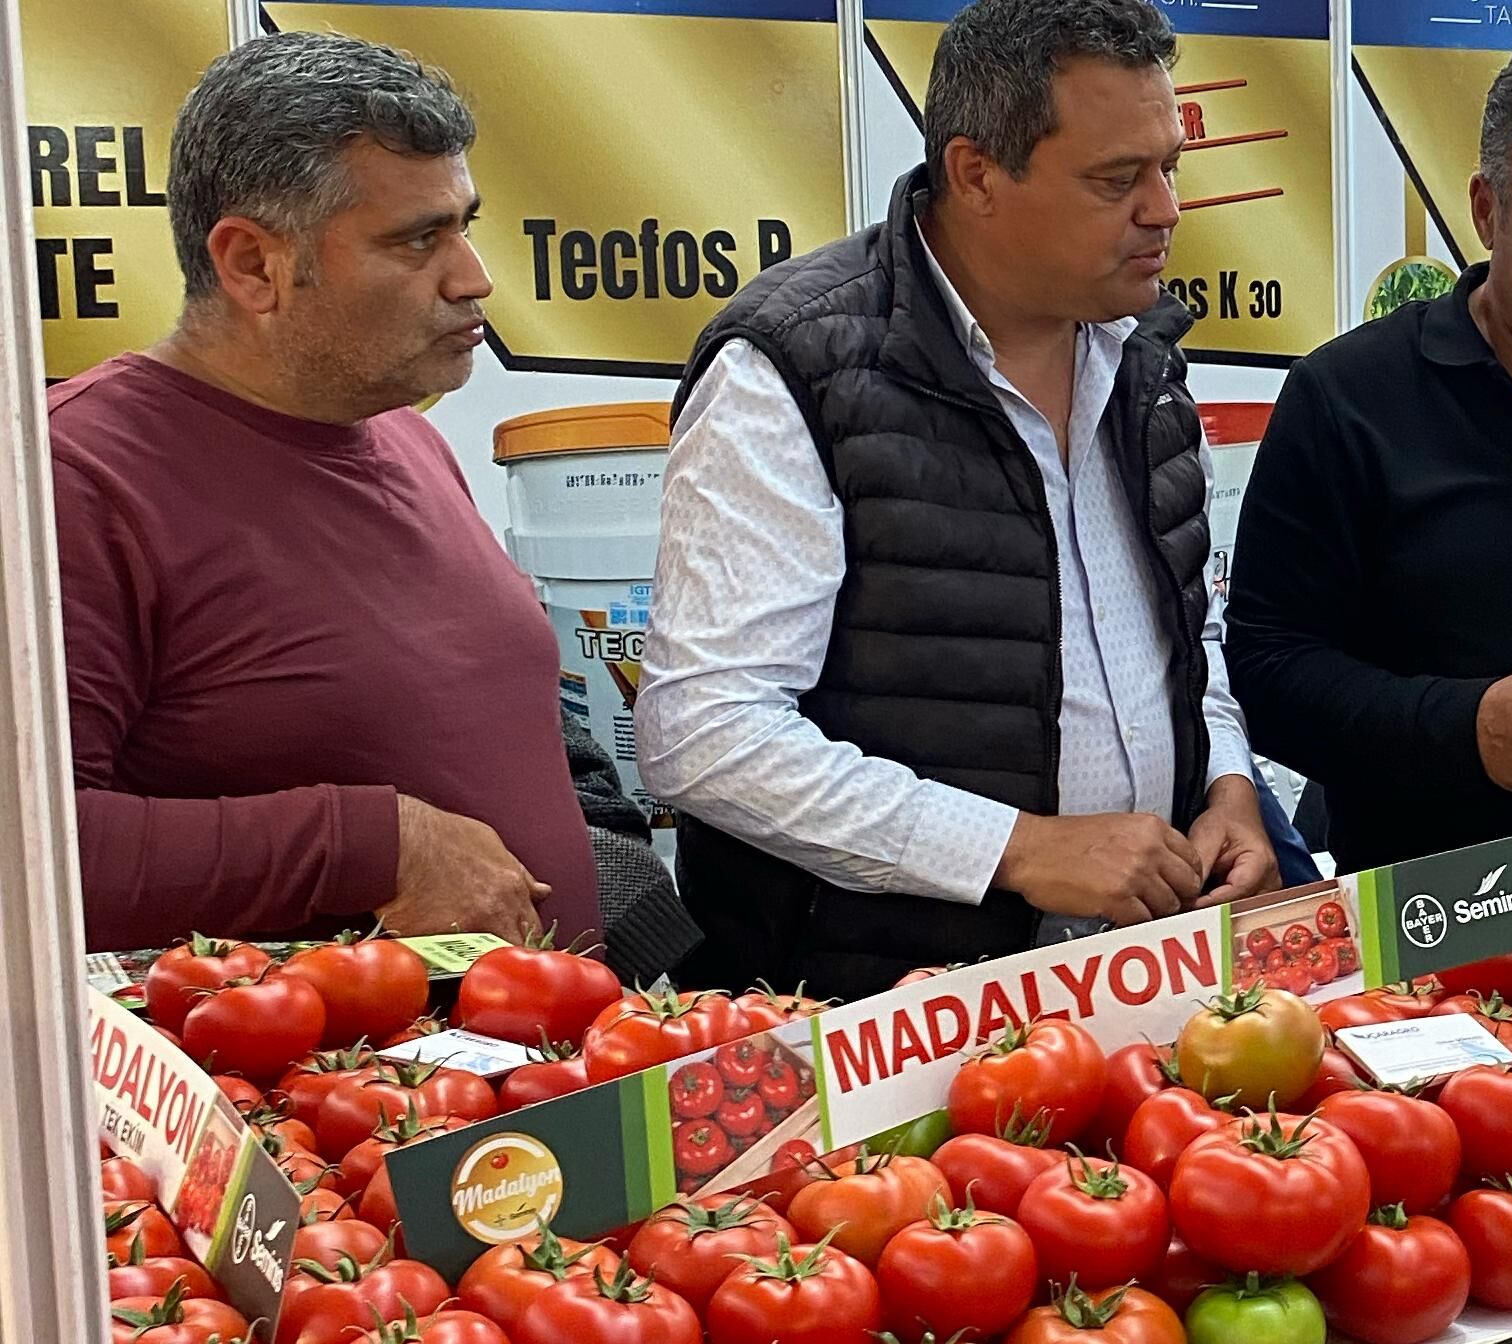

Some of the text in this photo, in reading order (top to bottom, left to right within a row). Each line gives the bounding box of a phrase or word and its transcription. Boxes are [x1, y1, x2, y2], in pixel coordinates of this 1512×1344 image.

[523, 217, 739, 301] Tecfos
[1219, 271, 1240, 320] K
[1248, 279, 1282, 319] 30
[1405, 912, 1444, 930] BAYER
[826, 929, 1218, 1094] MADALYON
[453, 1167, 561, 1216] Madalyon
